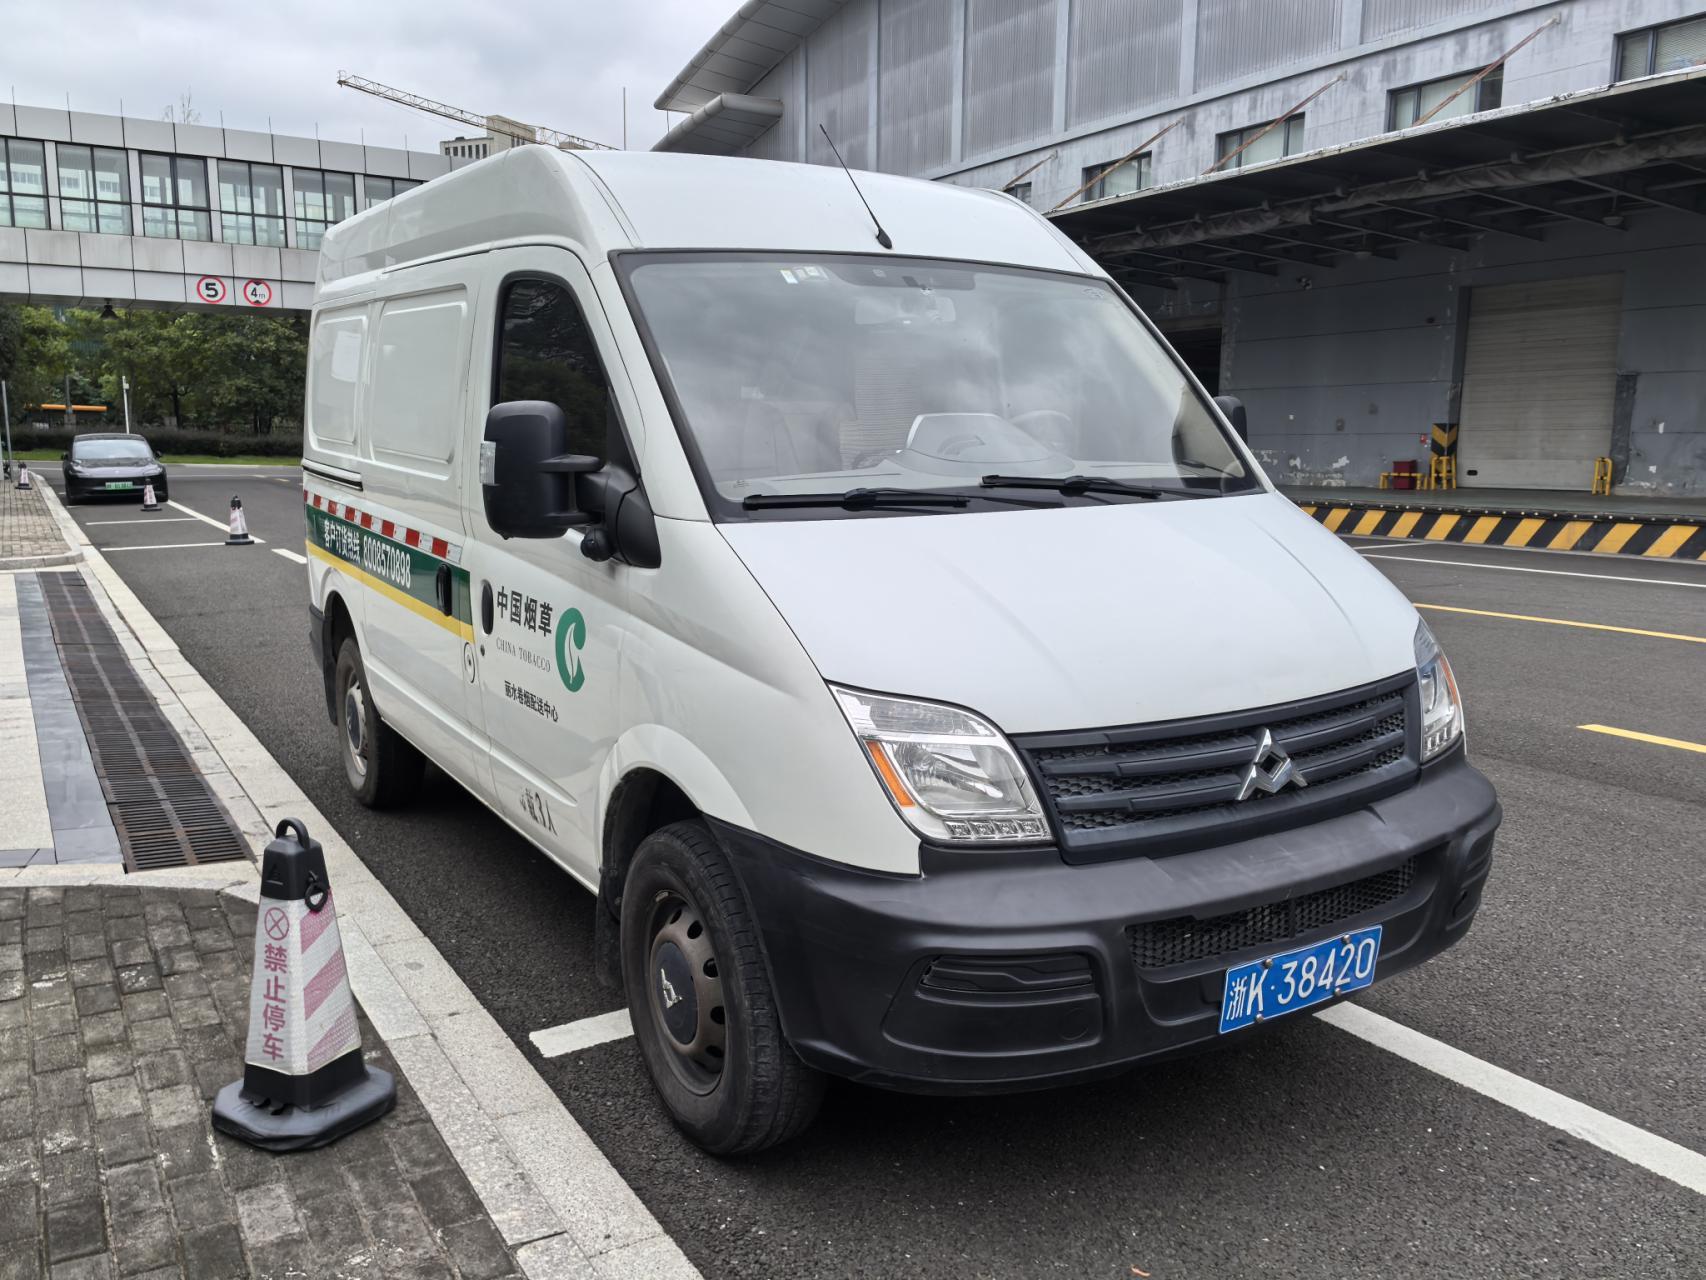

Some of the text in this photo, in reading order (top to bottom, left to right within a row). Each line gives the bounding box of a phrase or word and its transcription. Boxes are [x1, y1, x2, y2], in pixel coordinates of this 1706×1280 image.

[205, 282, 219, 298] 5
[363, 535, 411, 589] 8008570898
[496, 585, 553, 637] 中国烟草
[495, 636, 551, 673] CHINA TOBACCO
[504, 680, 559, 723] 丽水卷烟配送中心
[262, 943, 288, 1062] 禁止停车
[1226, 938, 1376, 1021] 浙K·38420
